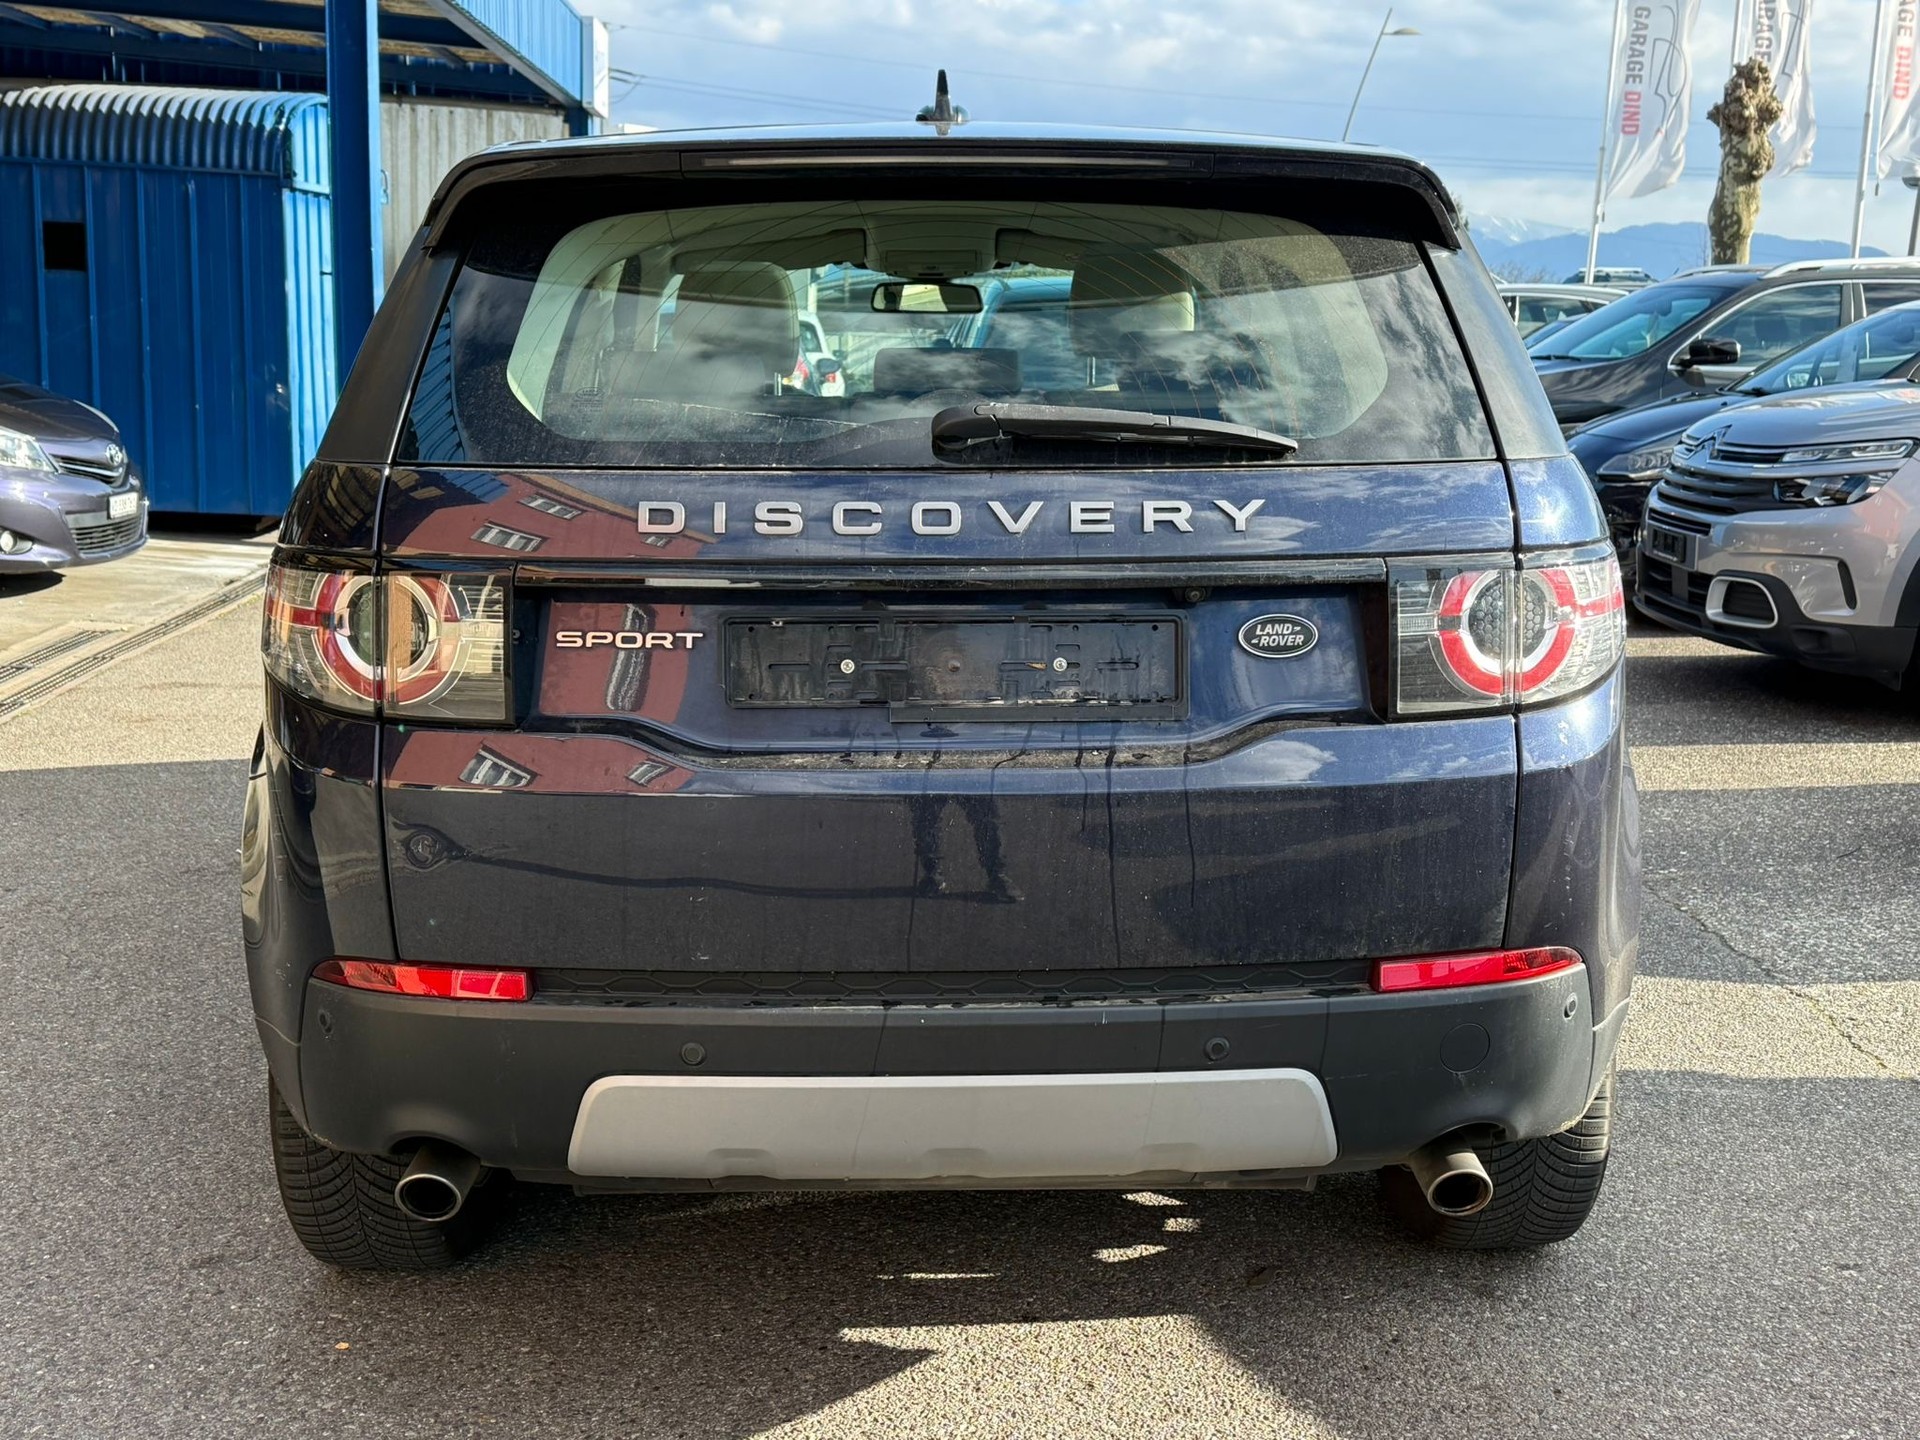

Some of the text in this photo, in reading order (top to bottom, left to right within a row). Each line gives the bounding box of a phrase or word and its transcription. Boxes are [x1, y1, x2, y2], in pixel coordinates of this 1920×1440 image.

[1754, 0, 1777, 62] RAGE
[1625, 6, 1651, 84] GARAGE
[637, 499, 1266, 536] DISCOVERY
[556, 631, 704, 649] SPORT
[1255, 623, 1293, 635] LAND
[1259, 634, 1305, 647] ROVER
